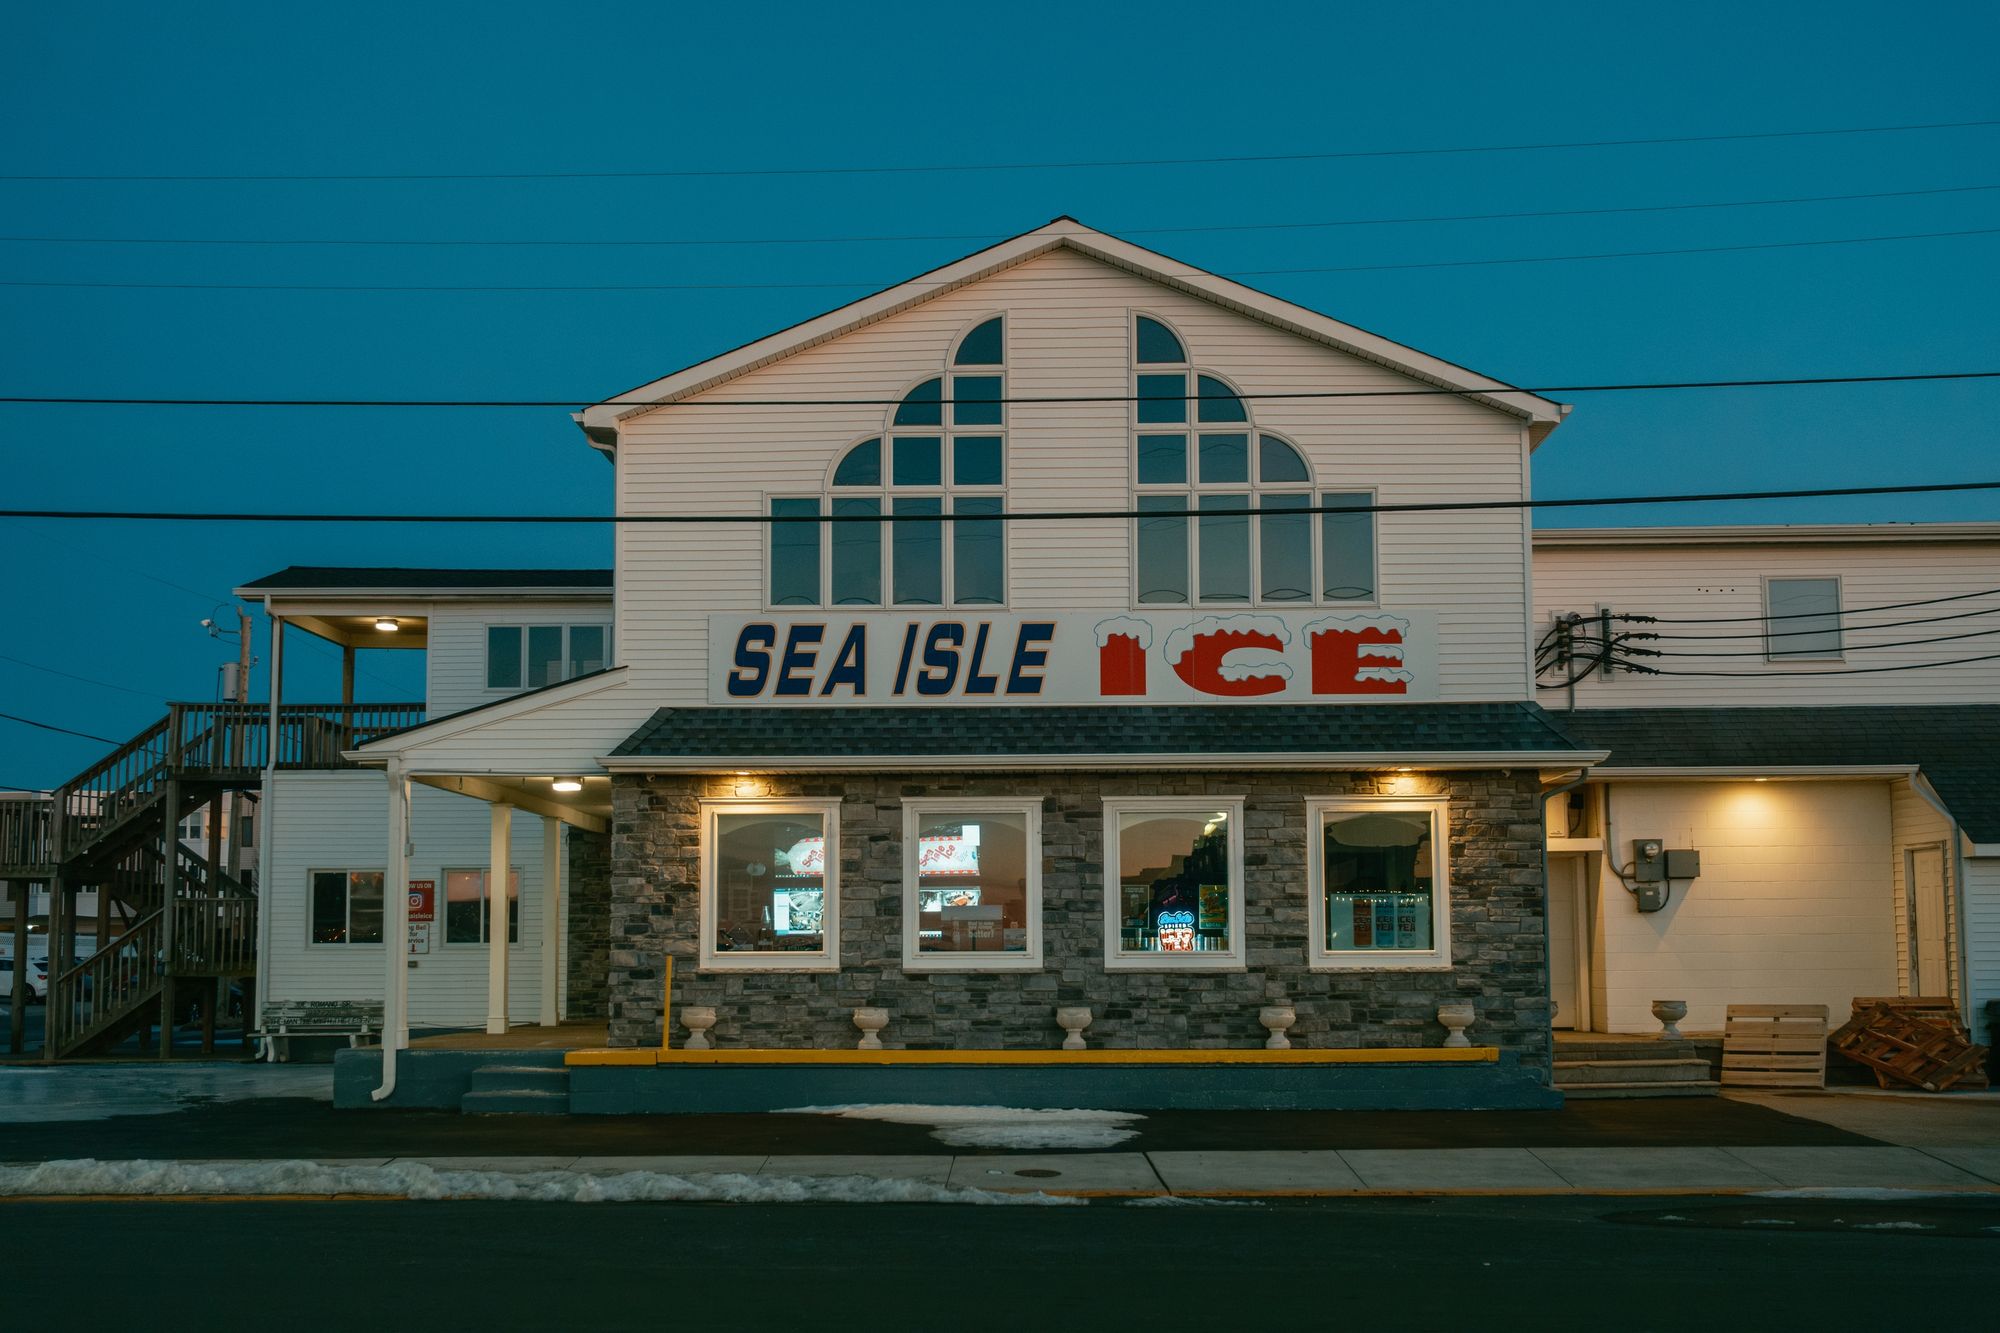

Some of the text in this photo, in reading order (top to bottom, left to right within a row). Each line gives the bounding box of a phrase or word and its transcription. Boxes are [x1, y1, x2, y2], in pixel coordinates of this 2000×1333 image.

[726, 614, 1415, 698] SEA ISLE ICE
[919, 849, 934, 867] Sea
[943, 844, 956, 860] Ice
